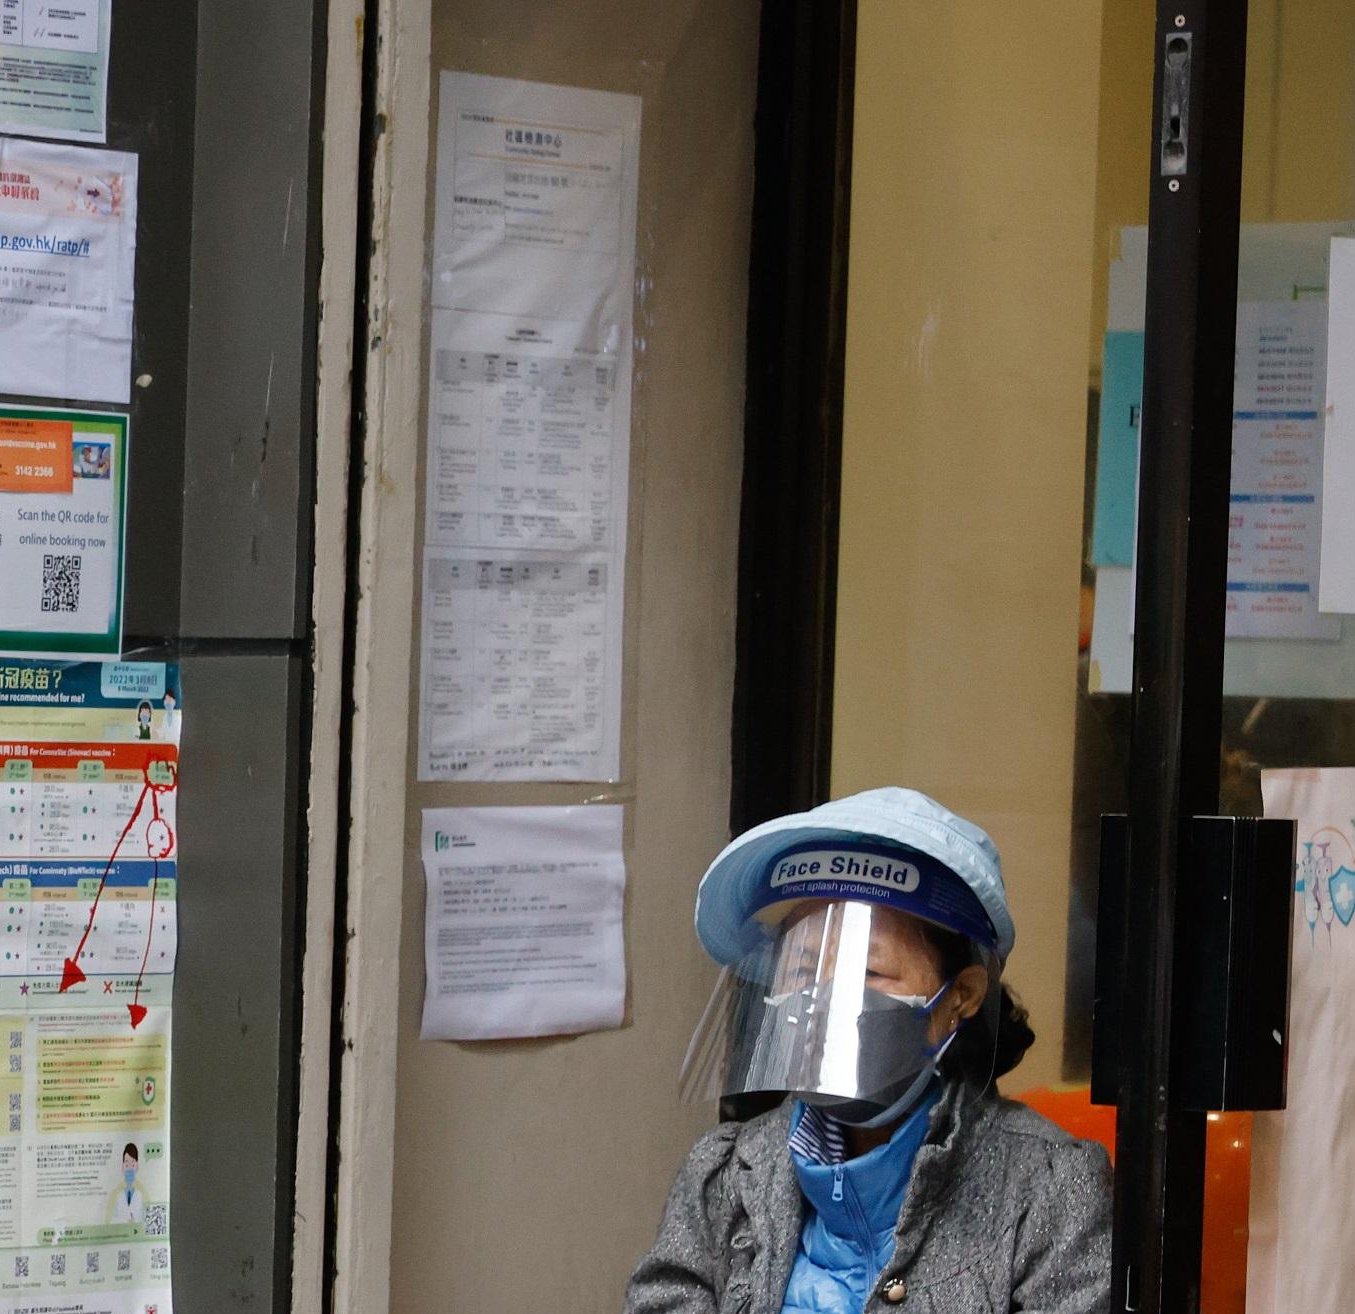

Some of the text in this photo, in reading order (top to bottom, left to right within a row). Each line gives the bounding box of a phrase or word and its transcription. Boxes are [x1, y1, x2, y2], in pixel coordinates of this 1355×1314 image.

[18, 509, 109, 523] Scan the QR code for
[19, 534, 106, 550] online booking now
[10, 692, 59, 703] recommended
[60, 693, 70, 703] for
[71, 692, 85, 703] me?
[777, 856, 908, 885] Face Shield
[807, 881, 890, 899] splash protection
